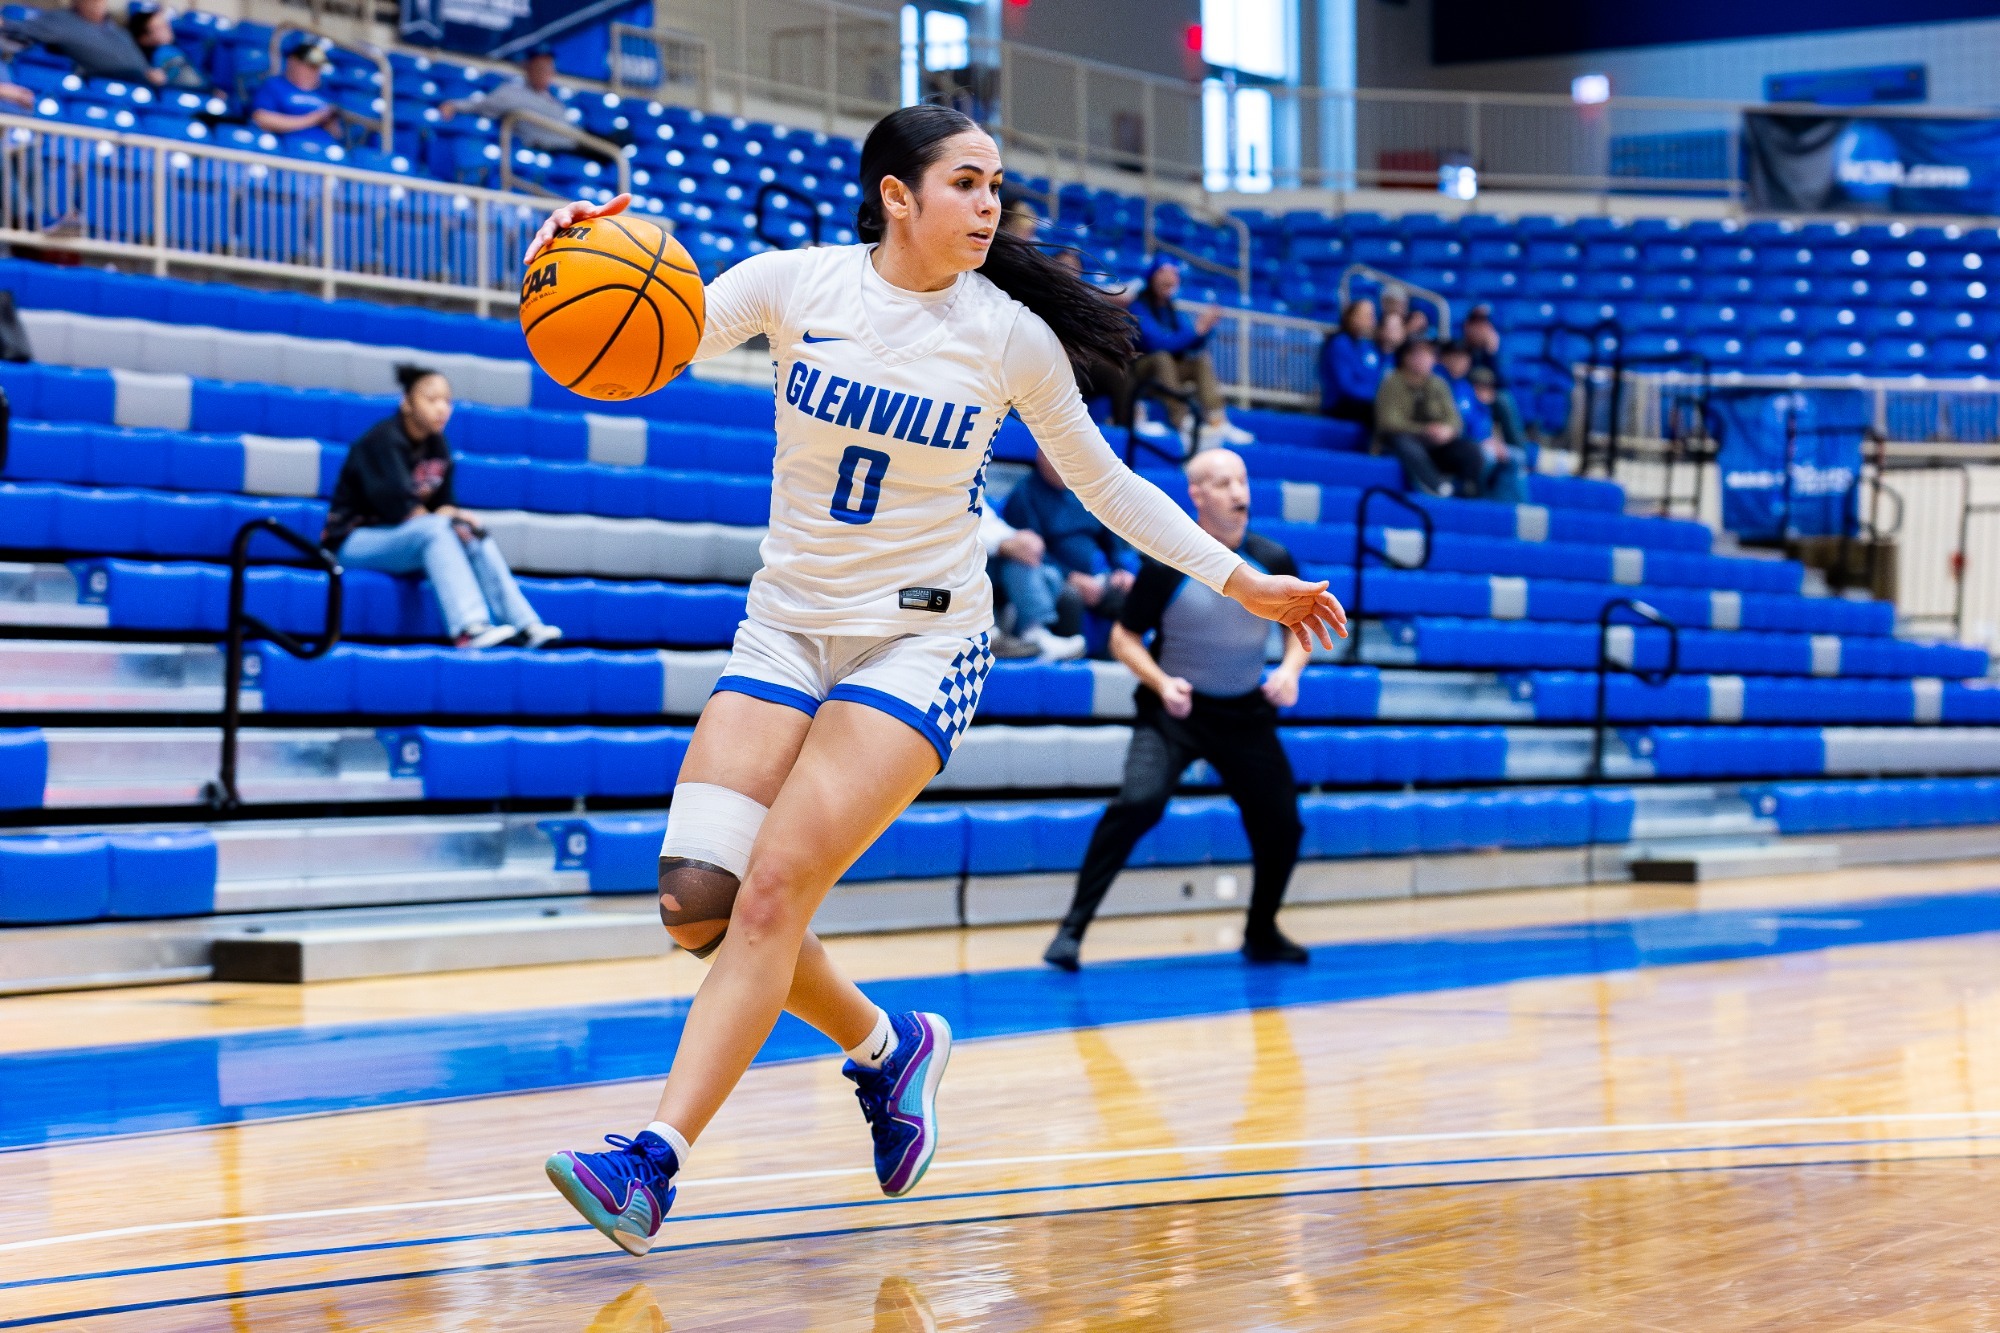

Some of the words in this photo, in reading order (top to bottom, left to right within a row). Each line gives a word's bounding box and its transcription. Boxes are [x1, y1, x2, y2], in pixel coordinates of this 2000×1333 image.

[521, 262, 557, 304] CAA
[785, 360, 982, 450] GLENVILLE
[829, 445, 891, 525] 0
[935, 595, 943, 606] S
